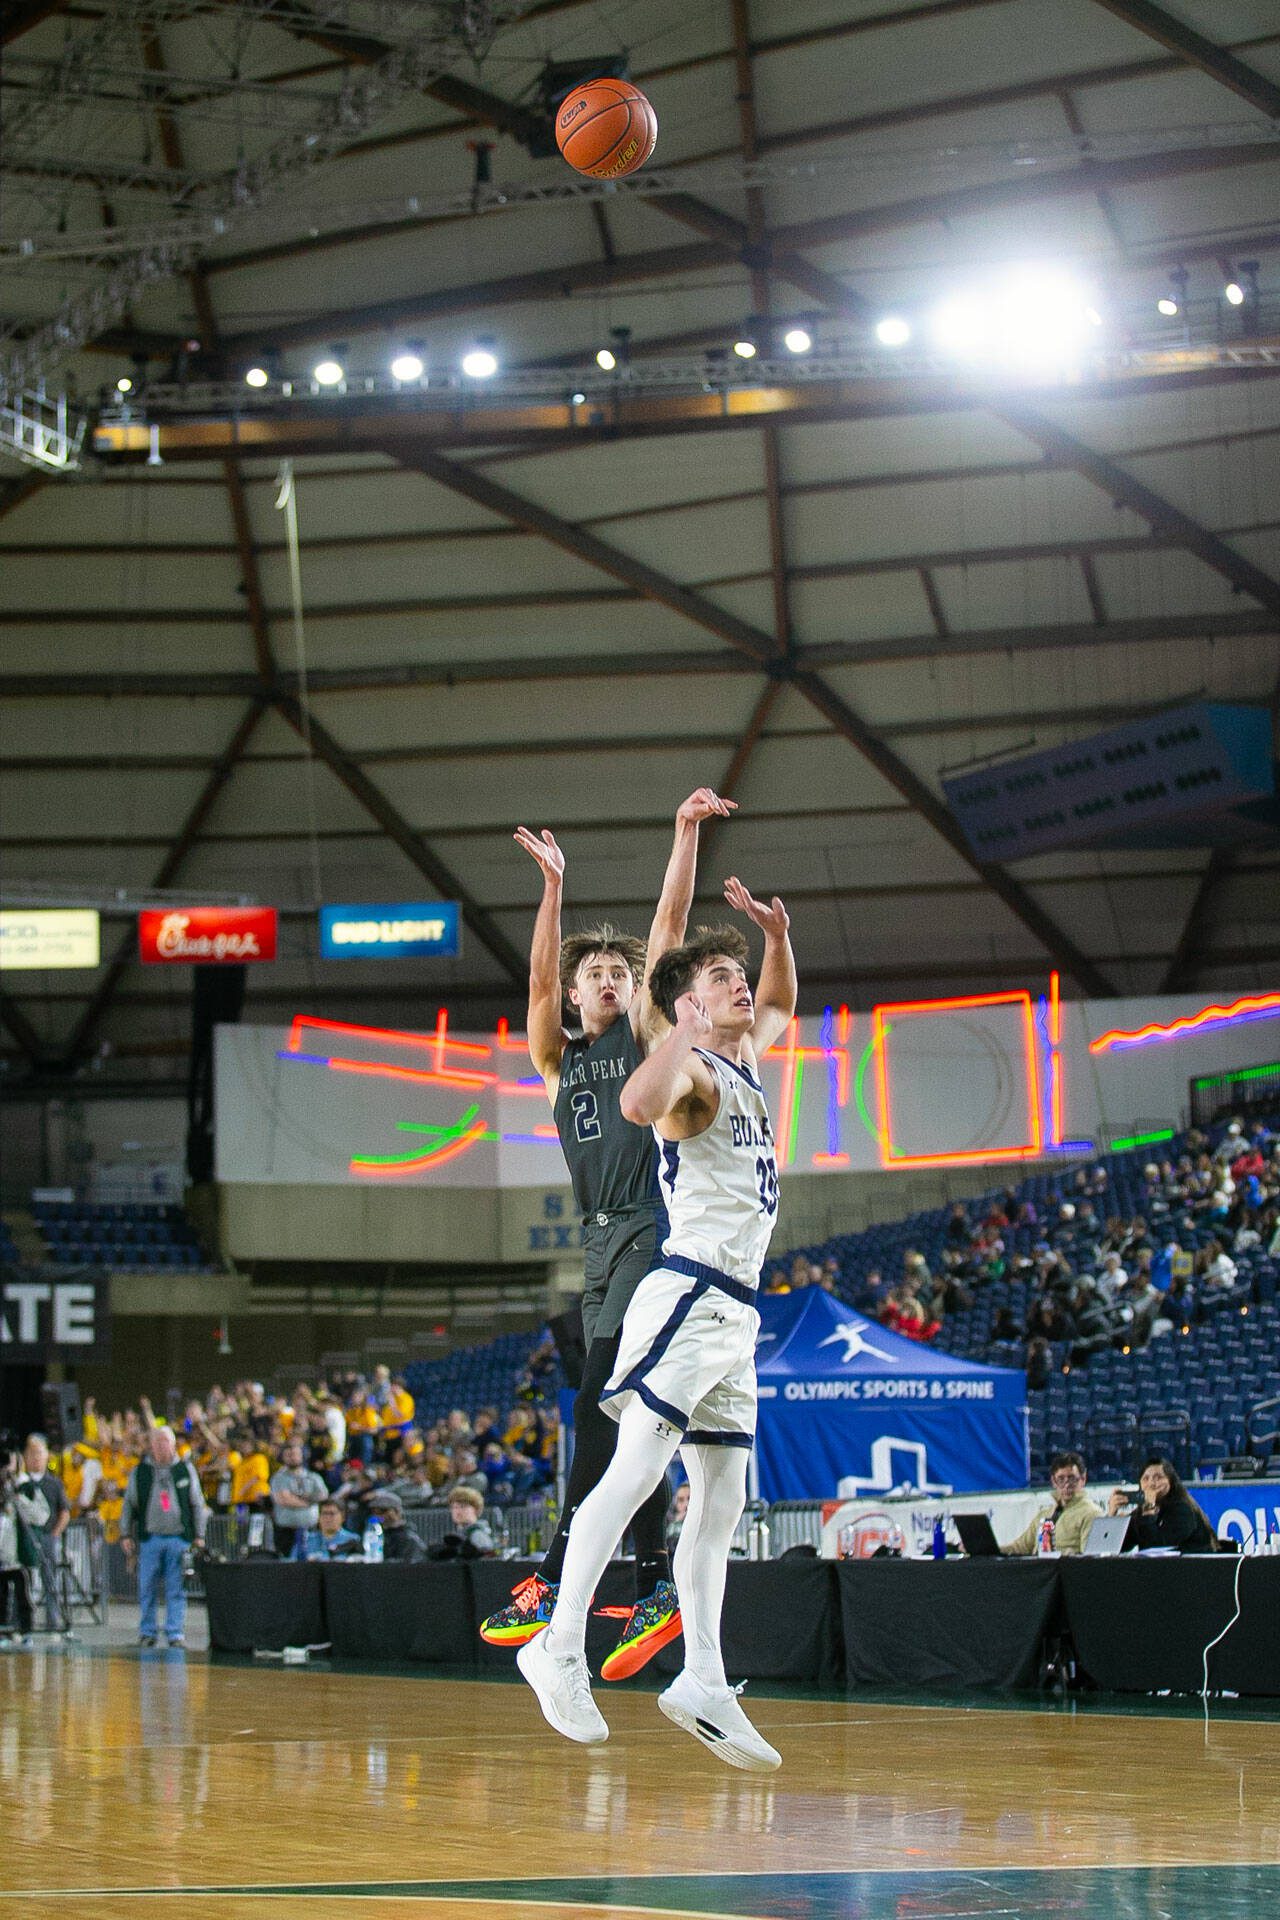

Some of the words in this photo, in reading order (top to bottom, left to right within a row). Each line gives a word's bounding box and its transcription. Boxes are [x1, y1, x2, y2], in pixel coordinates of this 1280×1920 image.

[332, 921, 379, 944] BUD
[380, 919, 445, 943] LIGHT
[591, 1057, 626, 1080] PEAK
[571, 1090, 602, 1143] 2
[784, 1380, 861, 1400] OLYMPIC
[862, 1380, 928, 1399] SPORTS
[930, 1381, 944, 1399] &
[945, 1380, 994, 1399] SPINE
